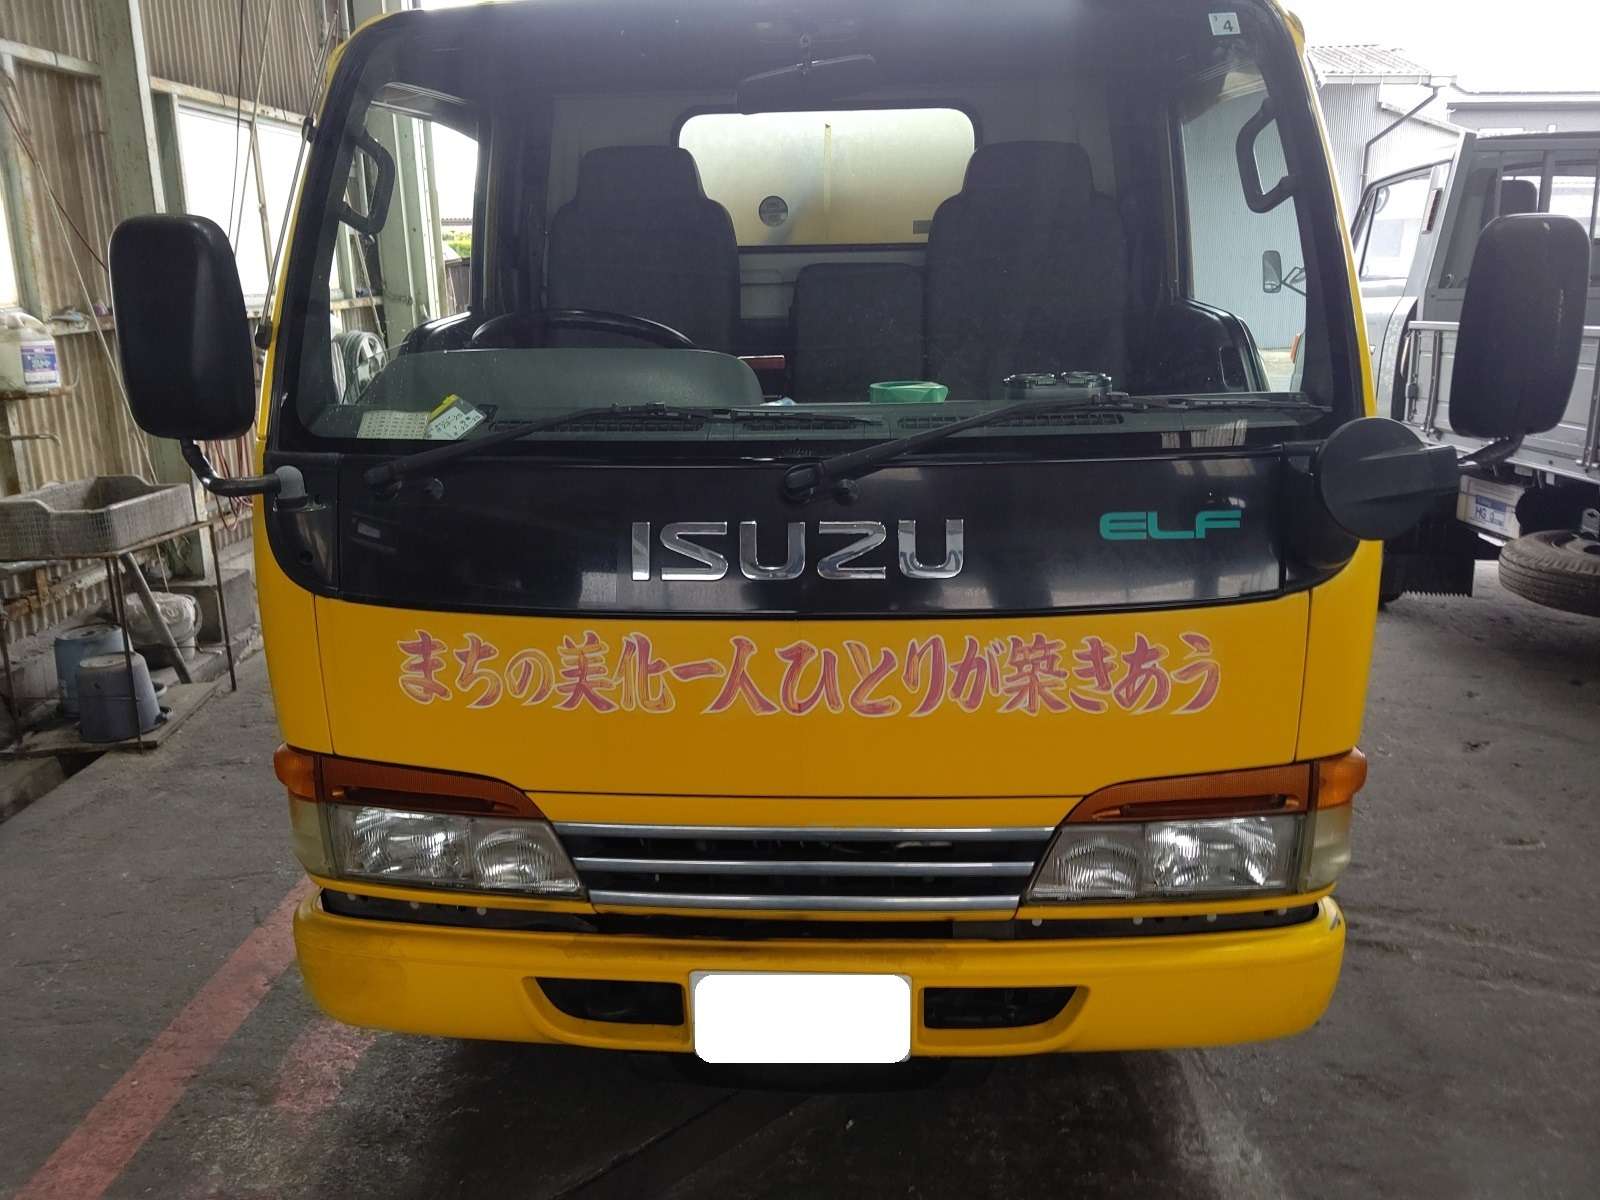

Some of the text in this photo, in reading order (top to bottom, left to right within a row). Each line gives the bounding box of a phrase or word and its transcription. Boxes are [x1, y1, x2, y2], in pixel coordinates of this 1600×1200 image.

[631, 520, 964, 581] ISUZU
[1100, 510, 1242, 540] ELF
[397, 629, 1221, 717] まちの美化一人ひとりが築きあう
